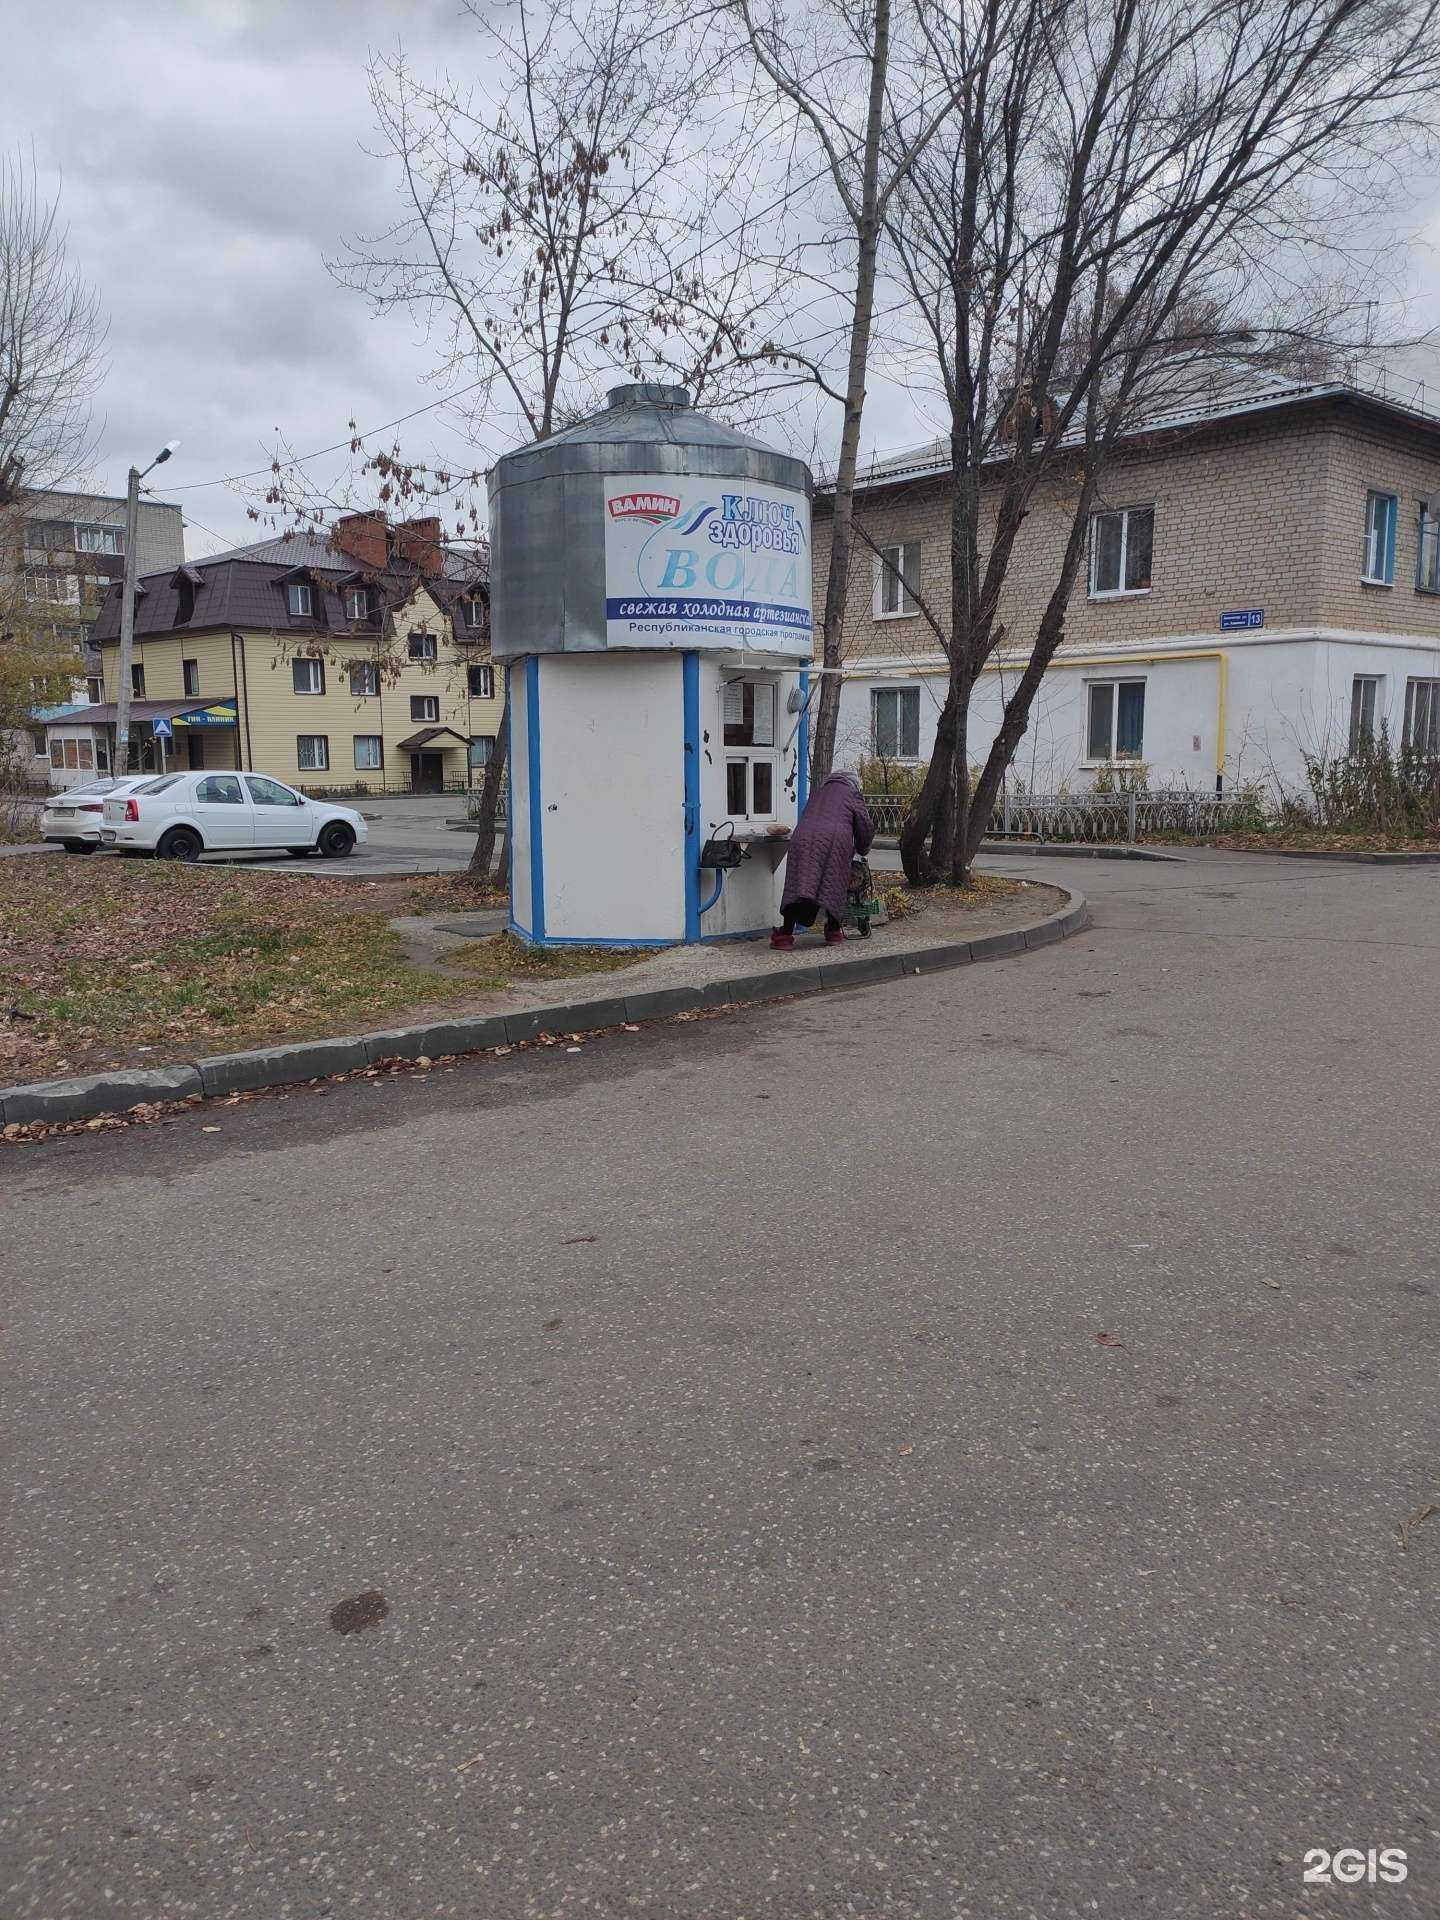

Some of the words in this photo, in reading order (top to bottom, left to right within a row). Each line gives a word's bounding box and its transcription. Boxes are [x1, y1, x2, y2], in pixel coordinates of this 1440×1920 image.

[611, 496, 677, 514] ВАМИН
[721, 494, 795, 531] КЛЮЧ
[620, 602, 678, 615] свежая
[681, 600, 750, 617] холодная
[1251, 614, 1260, 624] 13
[629, 622, 732, 634] Республиканская
[734, 626, 778, 637] городская
